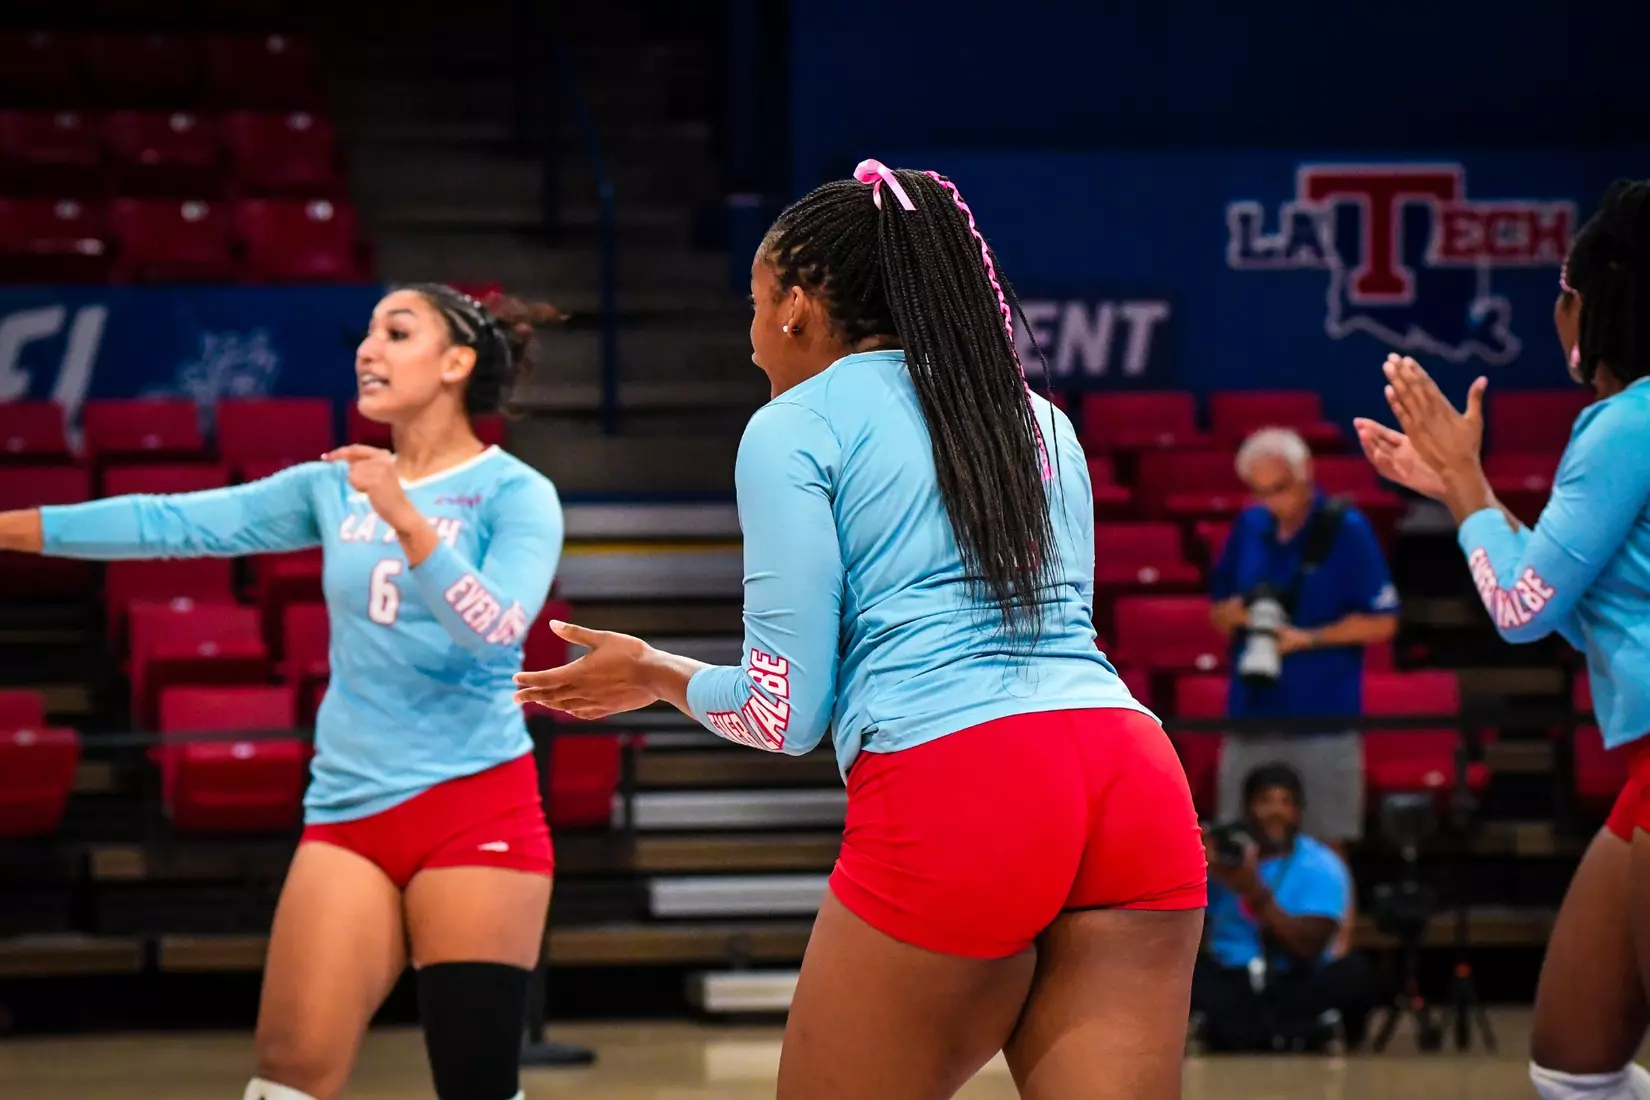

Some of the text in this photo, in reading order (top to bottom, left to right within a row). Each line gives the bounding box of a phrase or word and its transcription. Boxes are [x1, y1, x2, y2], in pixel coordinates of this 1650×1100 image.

[1226, 202, 1338, 269] LA
[369, 559, 402, 625] 6
[445, 574, 501, 634] EVER
